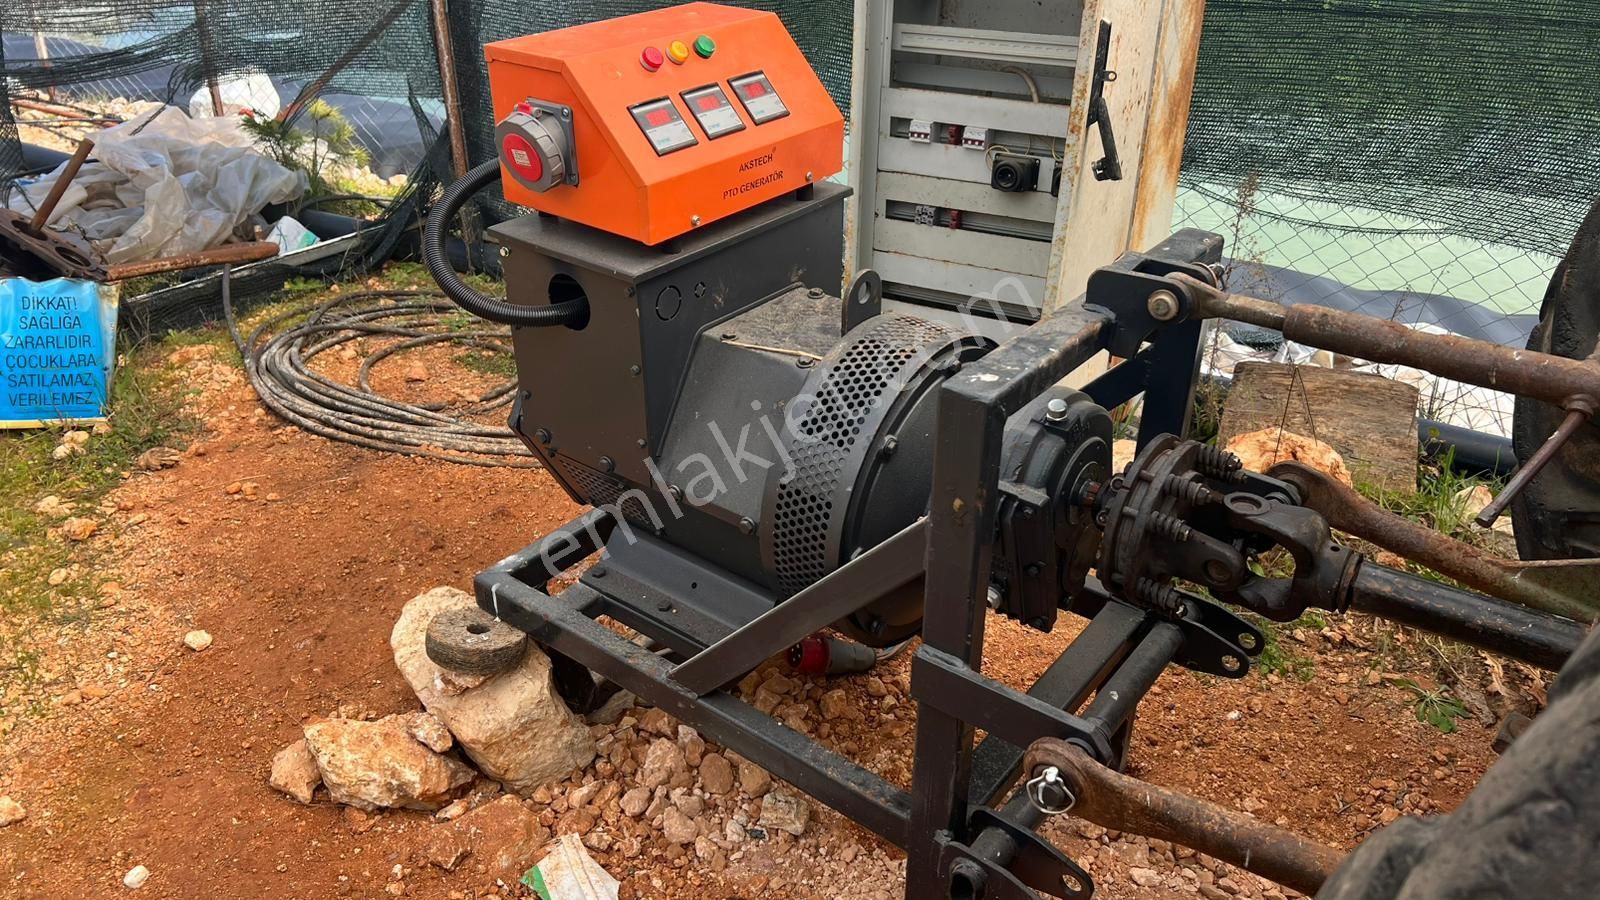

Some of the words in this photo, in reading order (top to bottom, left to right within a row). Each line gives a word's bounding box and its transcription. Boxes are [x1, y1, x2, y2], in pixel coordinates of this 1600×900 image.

[723, 187, 739, 200] PTO
[21, 292, 78, 311] DİKKAT!
[19, 312, 82, 330] SAĞLIĞA
[5, 354, 97, 372] ÇOCUKLARA
